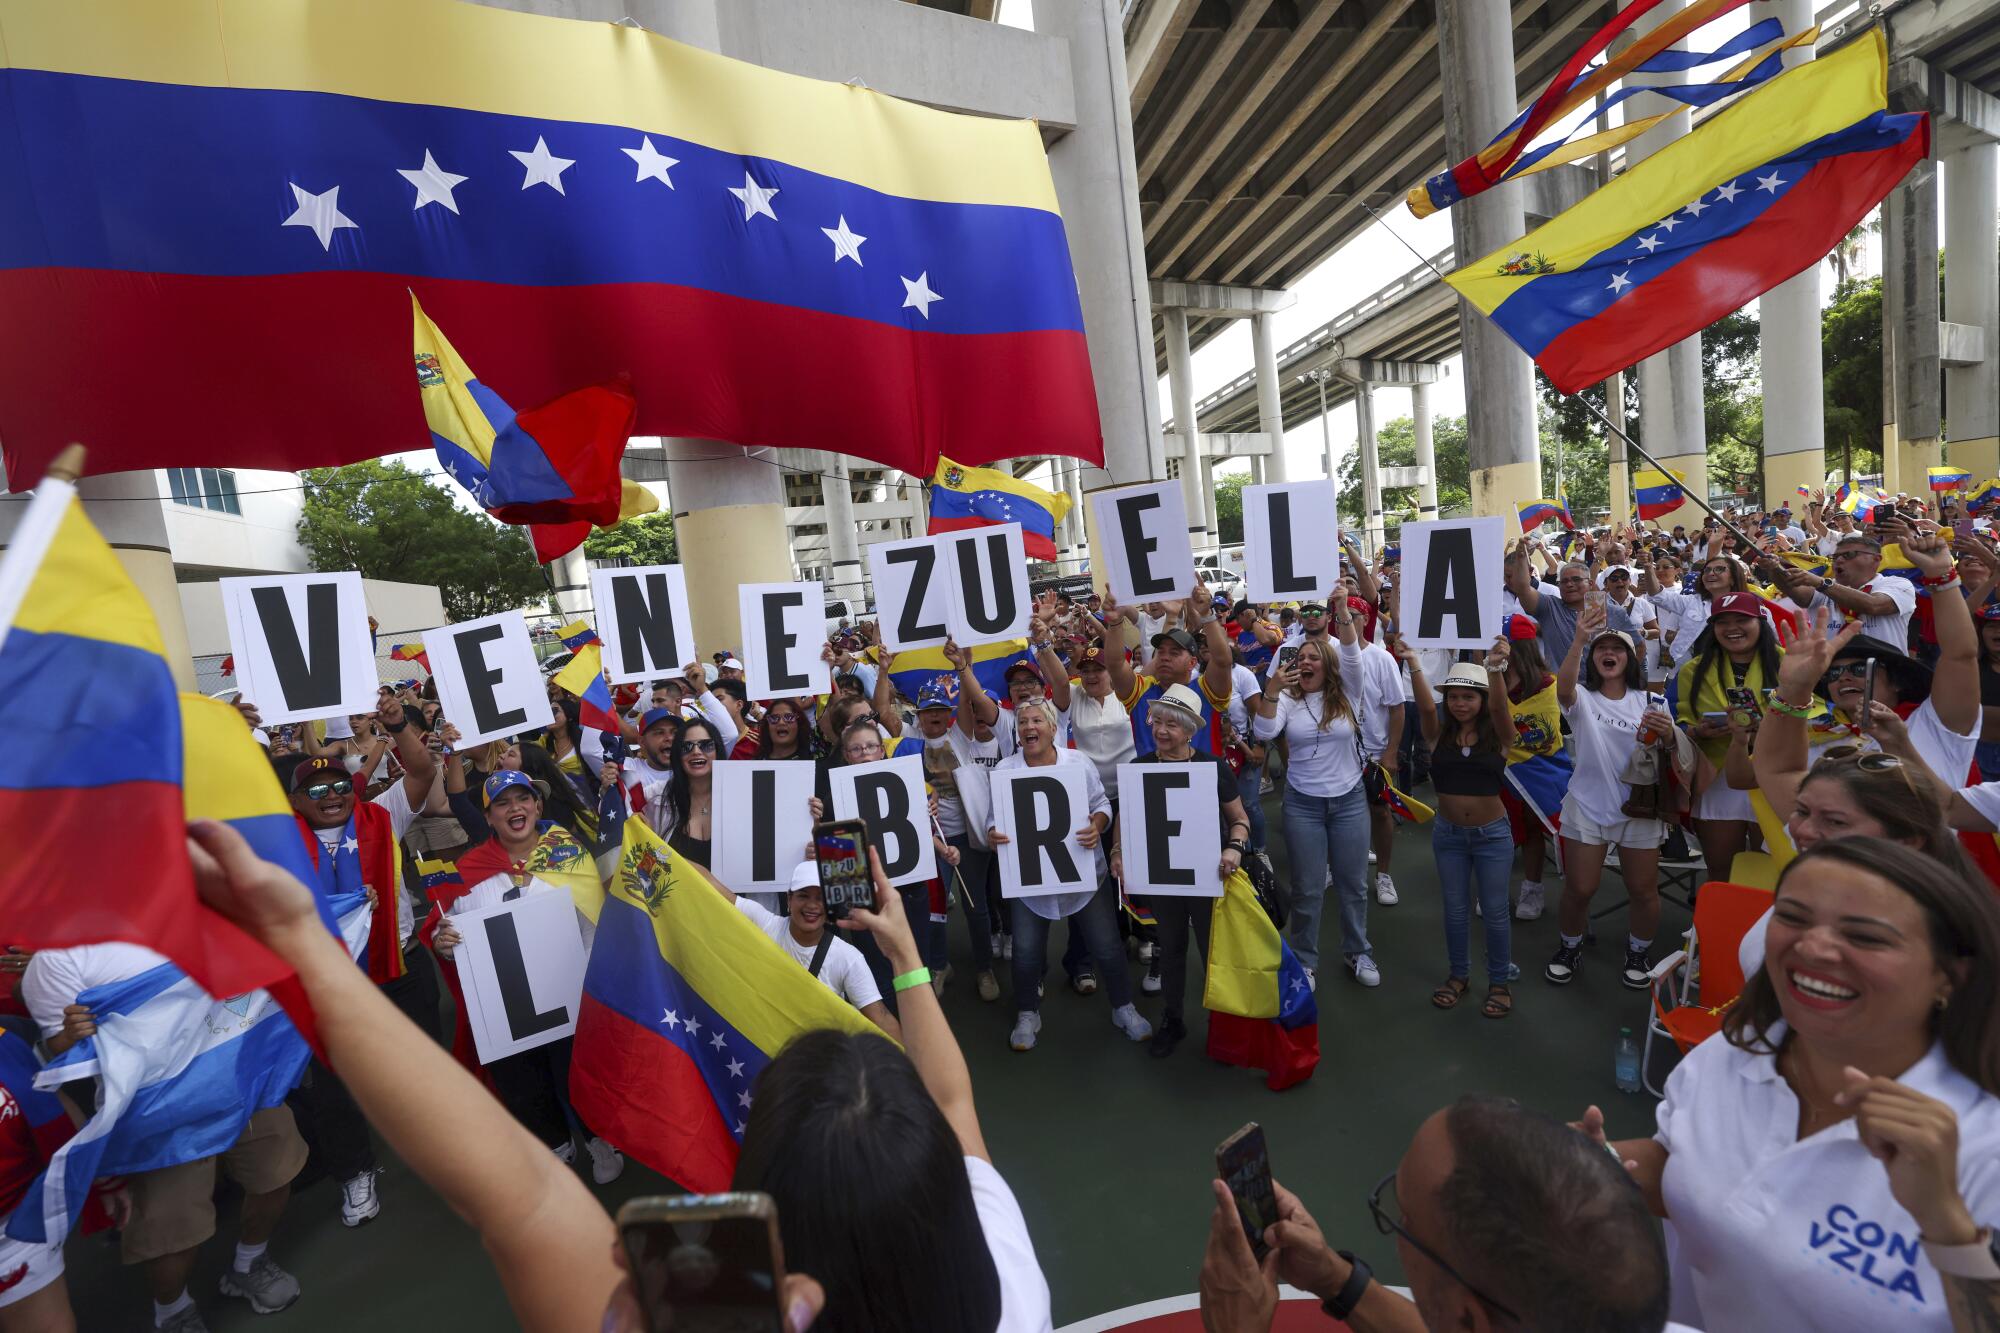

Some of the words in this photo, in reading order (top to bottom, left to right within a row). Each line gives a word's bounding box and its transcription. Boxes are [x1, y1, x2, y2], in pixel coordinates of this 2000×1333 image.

[886, 544, 947, 643] Z
[956, 534, 1016, 634] U
[1117, 492, 1175, 596] E
[1268, 491, 1317, 593] L
[1418, 528, 1482, 638] A
[251, 584, 341, 711] V
[612, 574, 679, 674] N
[763, 592, 810, 691] E
[454, 624, 527, 734] E
[752, 770, 776, 882] I
[854, 771, 920, 879] B
[1011, 776, 1082, 887] R
[1142, 771, 1196, 886] E
[484, 912, 570, 1042] L
[1809, 1221, 1926, 1304] VZLA
[1827, 1204, 1919, 1266] CON
